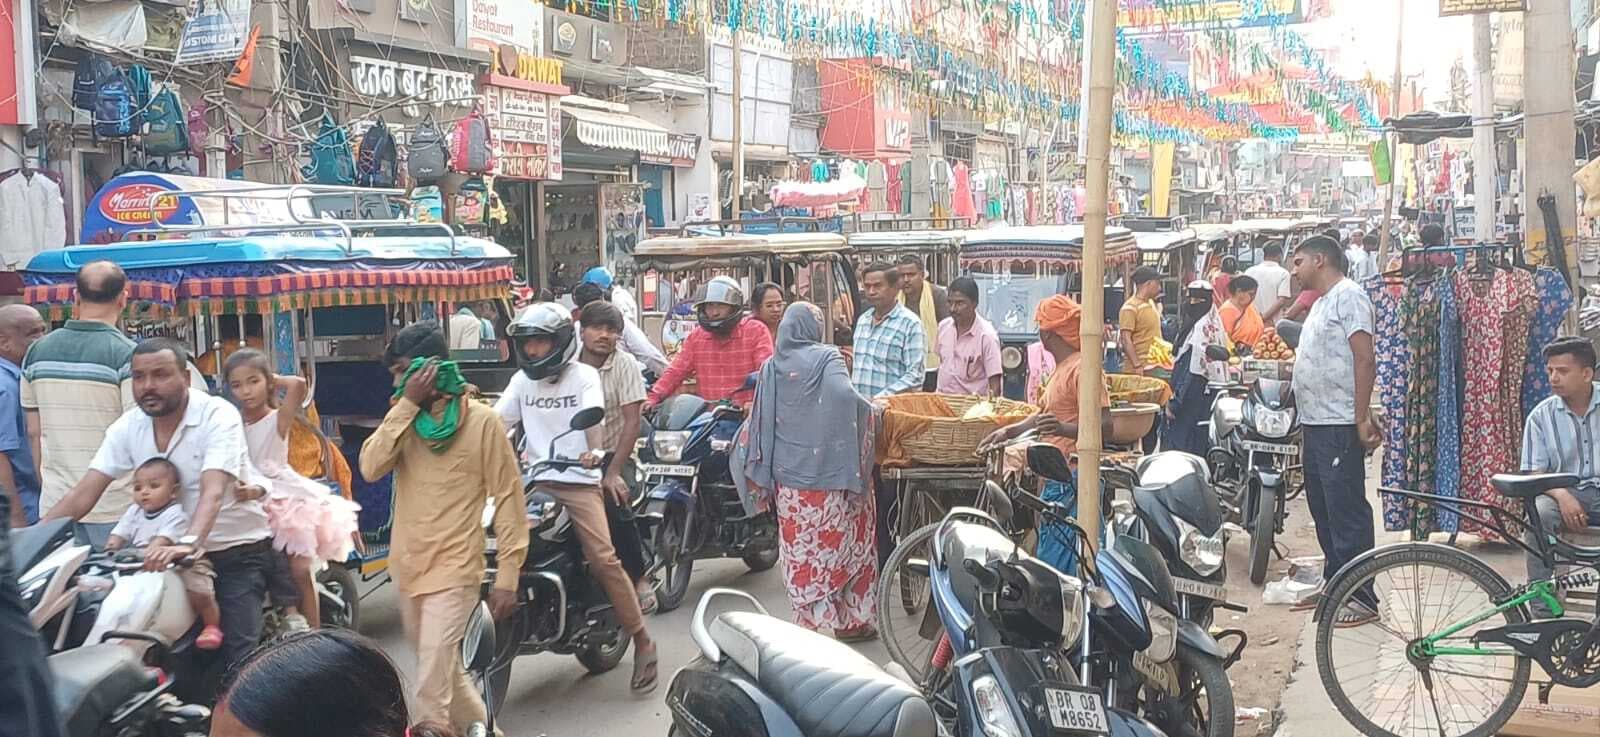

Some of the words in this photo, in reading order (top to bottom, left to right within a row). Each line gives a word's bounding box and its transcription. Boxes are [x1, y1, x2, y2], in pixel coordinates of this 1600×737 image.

[472, 14, 514, 38] Restaurant
[350, 55, 399, 97] रतन
[518, 56, 563, 85] DAWAT
[884, 118, 910, 147] VIP
[158, 195, 176, 207] 21
[116, 212, 130, 220] ICE
[1055, 691, 1074, 709] BR
[1080, 694, 1096, 711] 08
[1060, 709, 1102, 729] M8652
